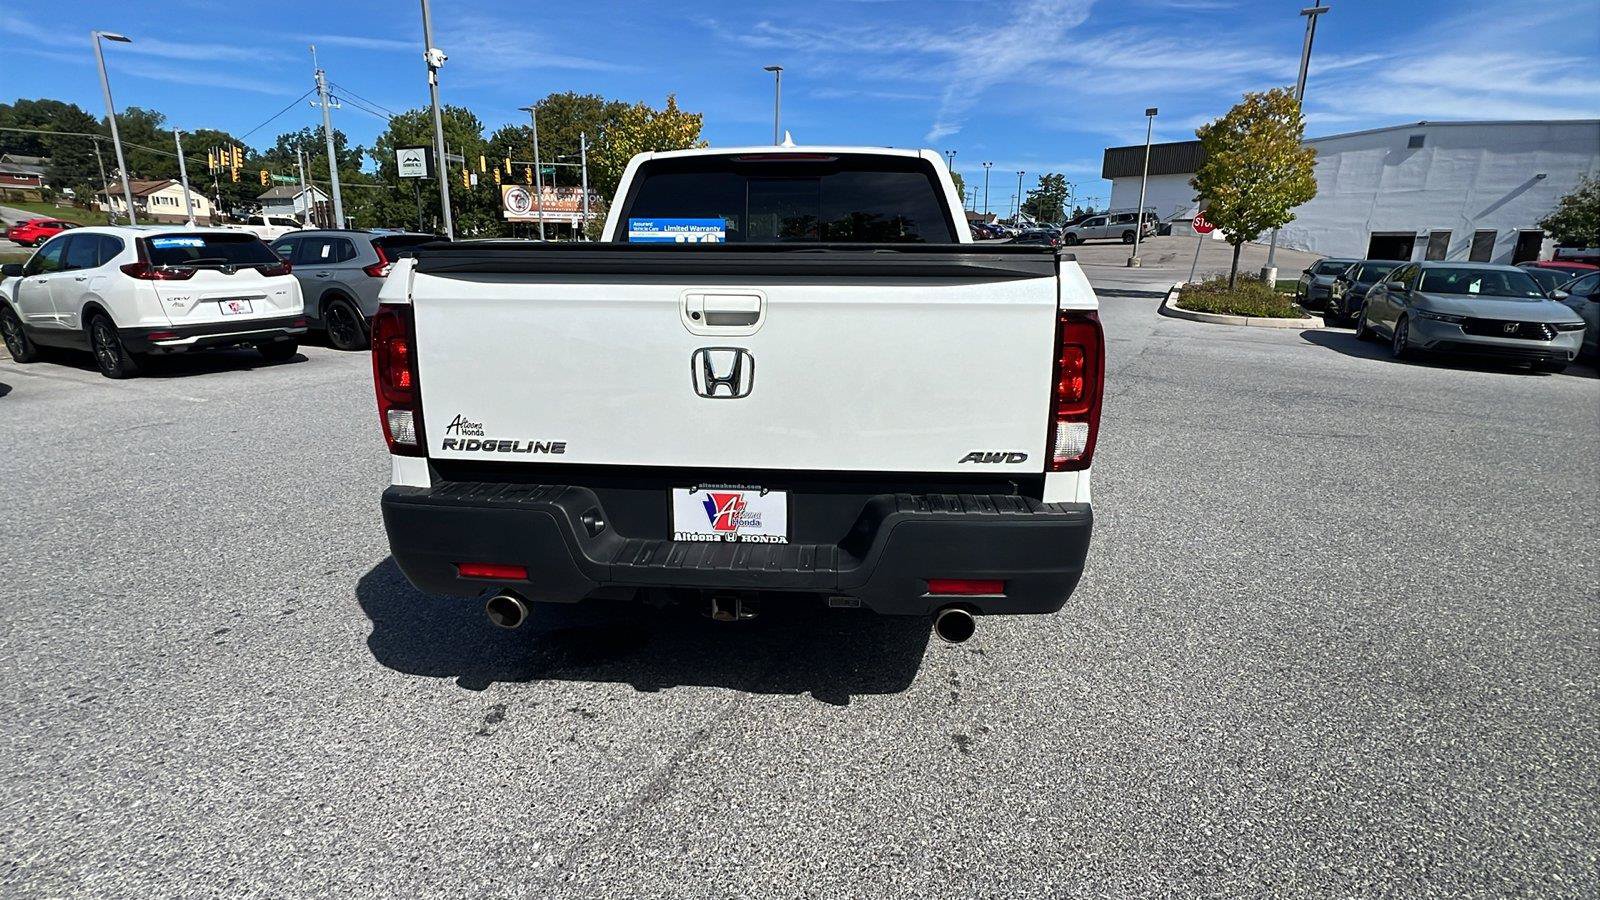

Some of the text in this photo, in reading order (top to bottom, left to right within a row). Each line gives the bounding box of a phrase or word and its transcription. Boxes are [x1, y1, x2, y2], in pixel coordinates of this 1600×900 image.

[1194, 217, 1213, 228] STO
[689, 225, 721, 233] Warranty
[443, 438, 566, 454] RIDGELINE
[958, 452, 1028, 463] AWD
[732, 519, 760, 527] Honda
[674, 532, 721, 542] Altoona
[742, 535, 788, 543] HONDA
